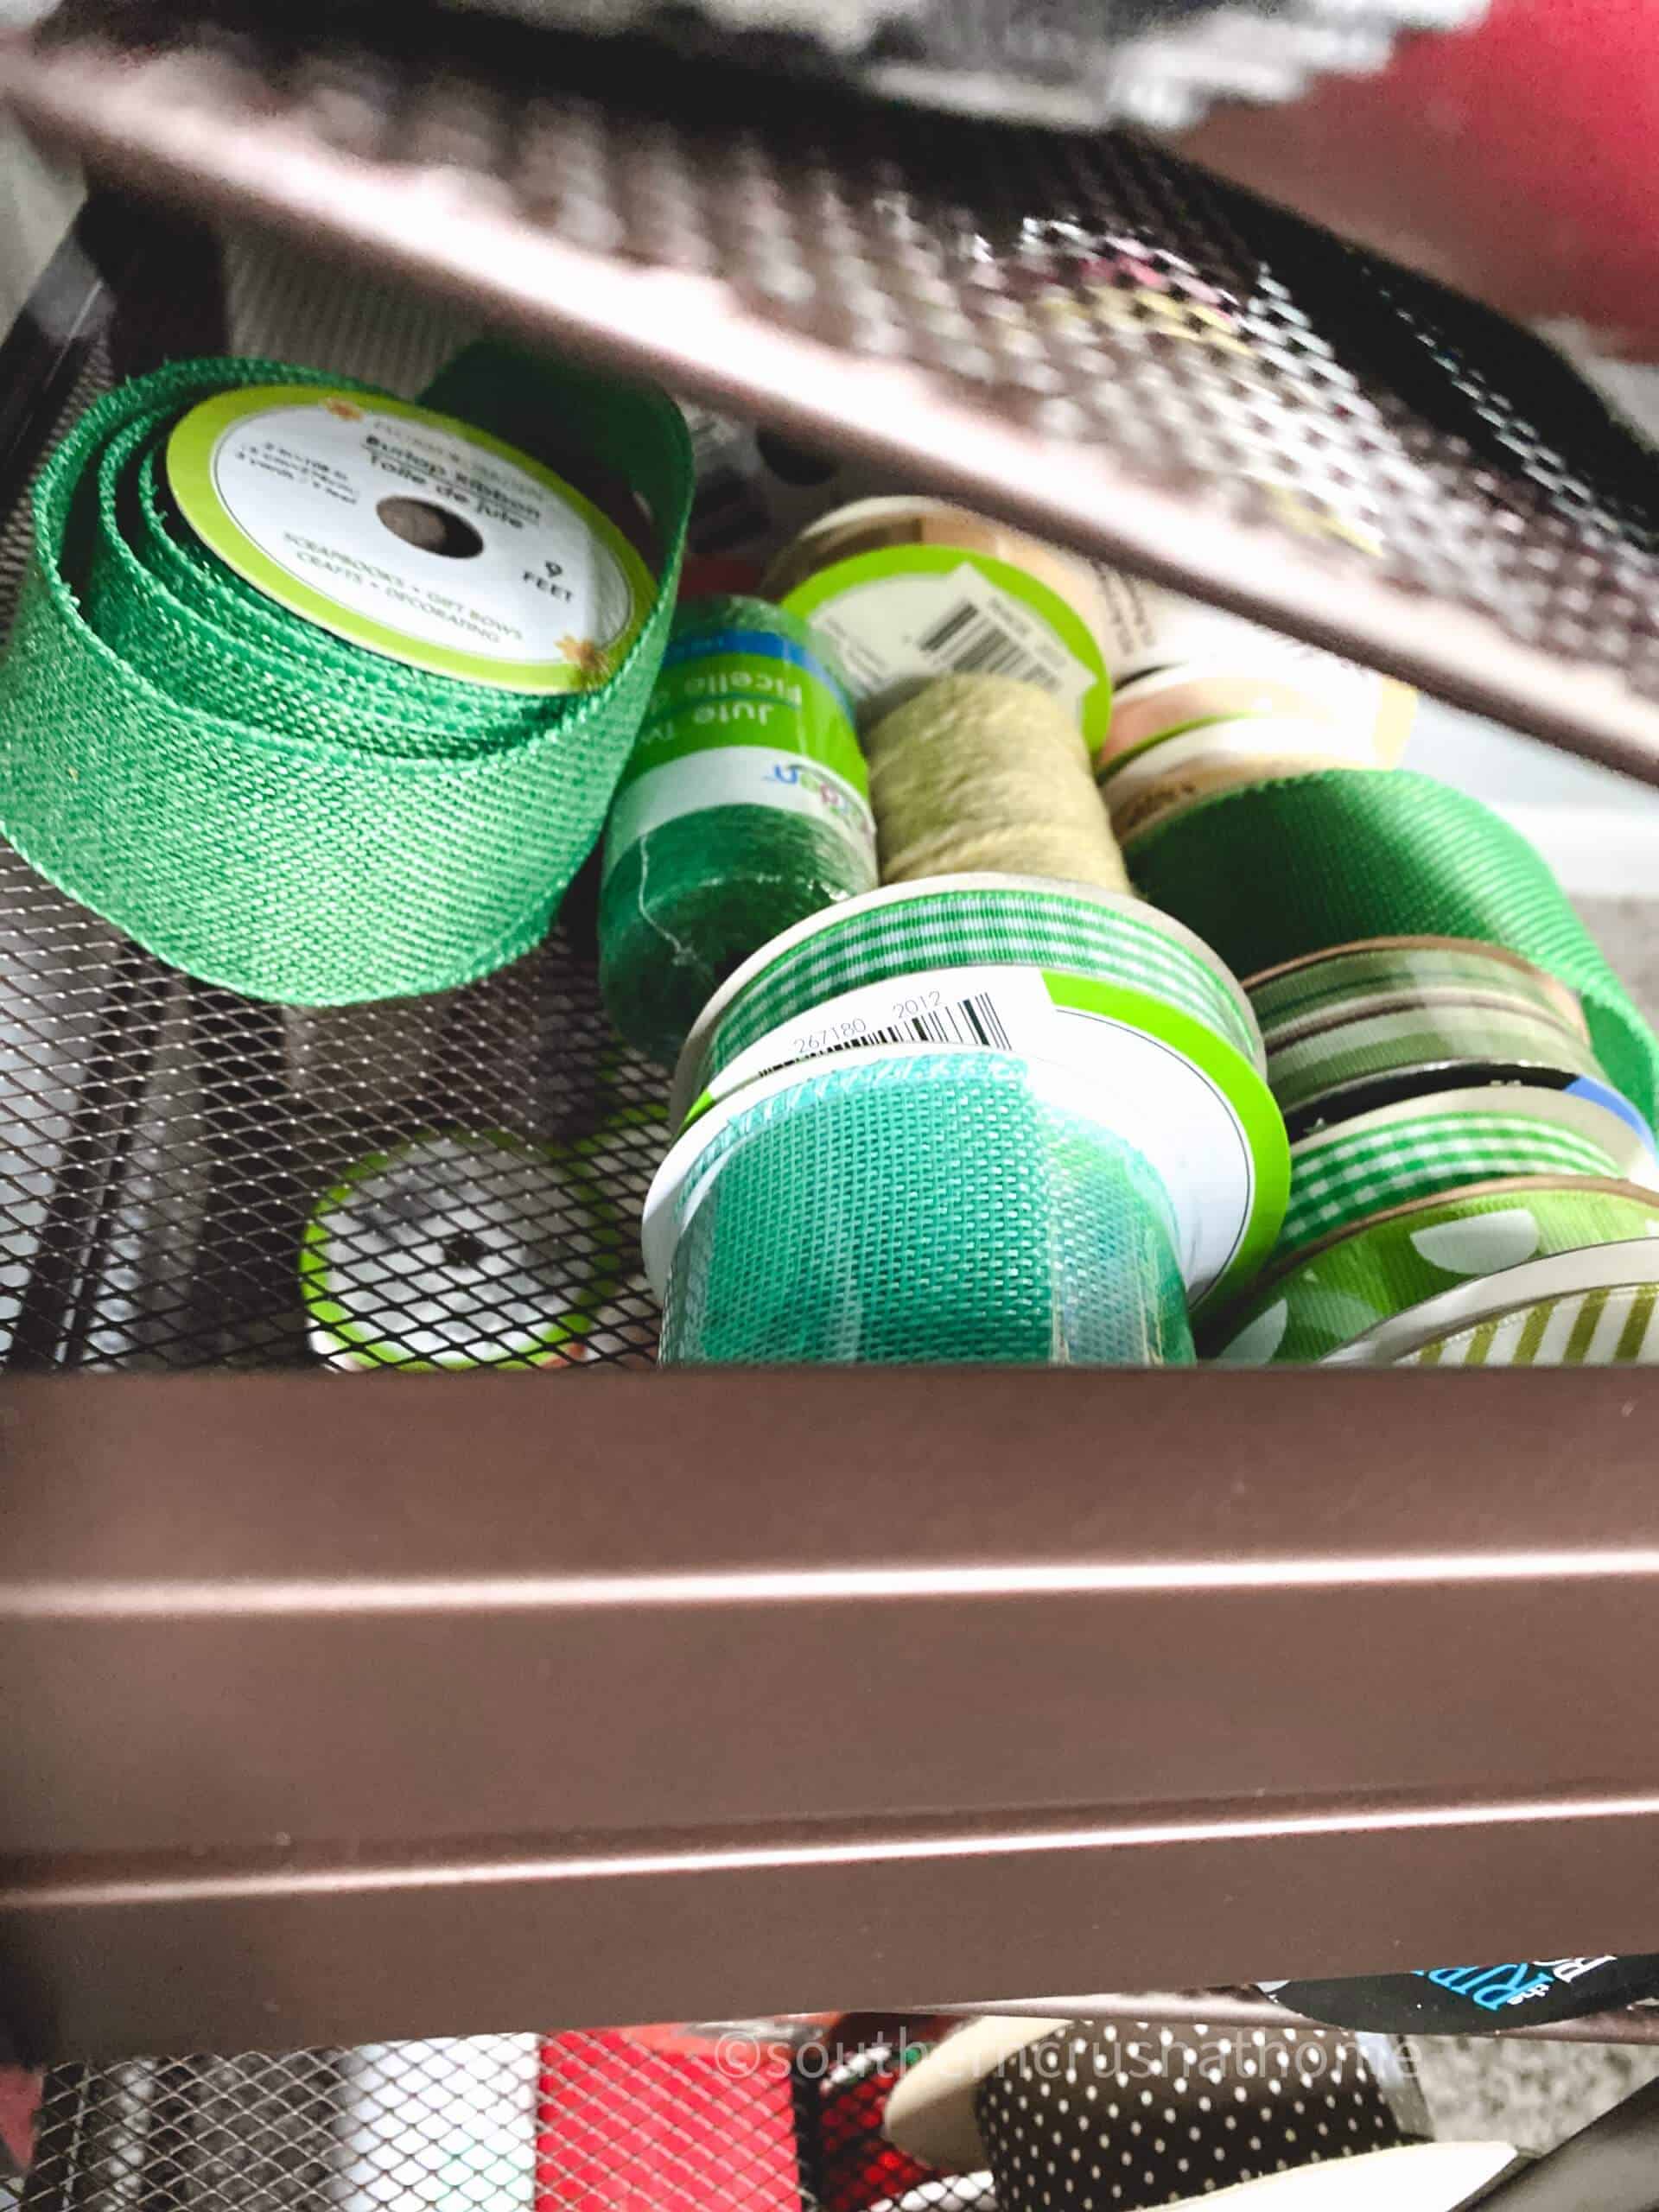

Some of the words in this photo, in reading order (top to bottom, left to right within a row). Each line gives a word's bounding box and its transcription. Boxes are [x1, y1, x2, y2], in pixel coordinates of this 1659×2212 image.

[435, 483, 471, 505] de
[523, 570, 573, 605] FEET
[792, 1016, 868, 1054] 267180
[893, 989, 942, 1020] 2012
